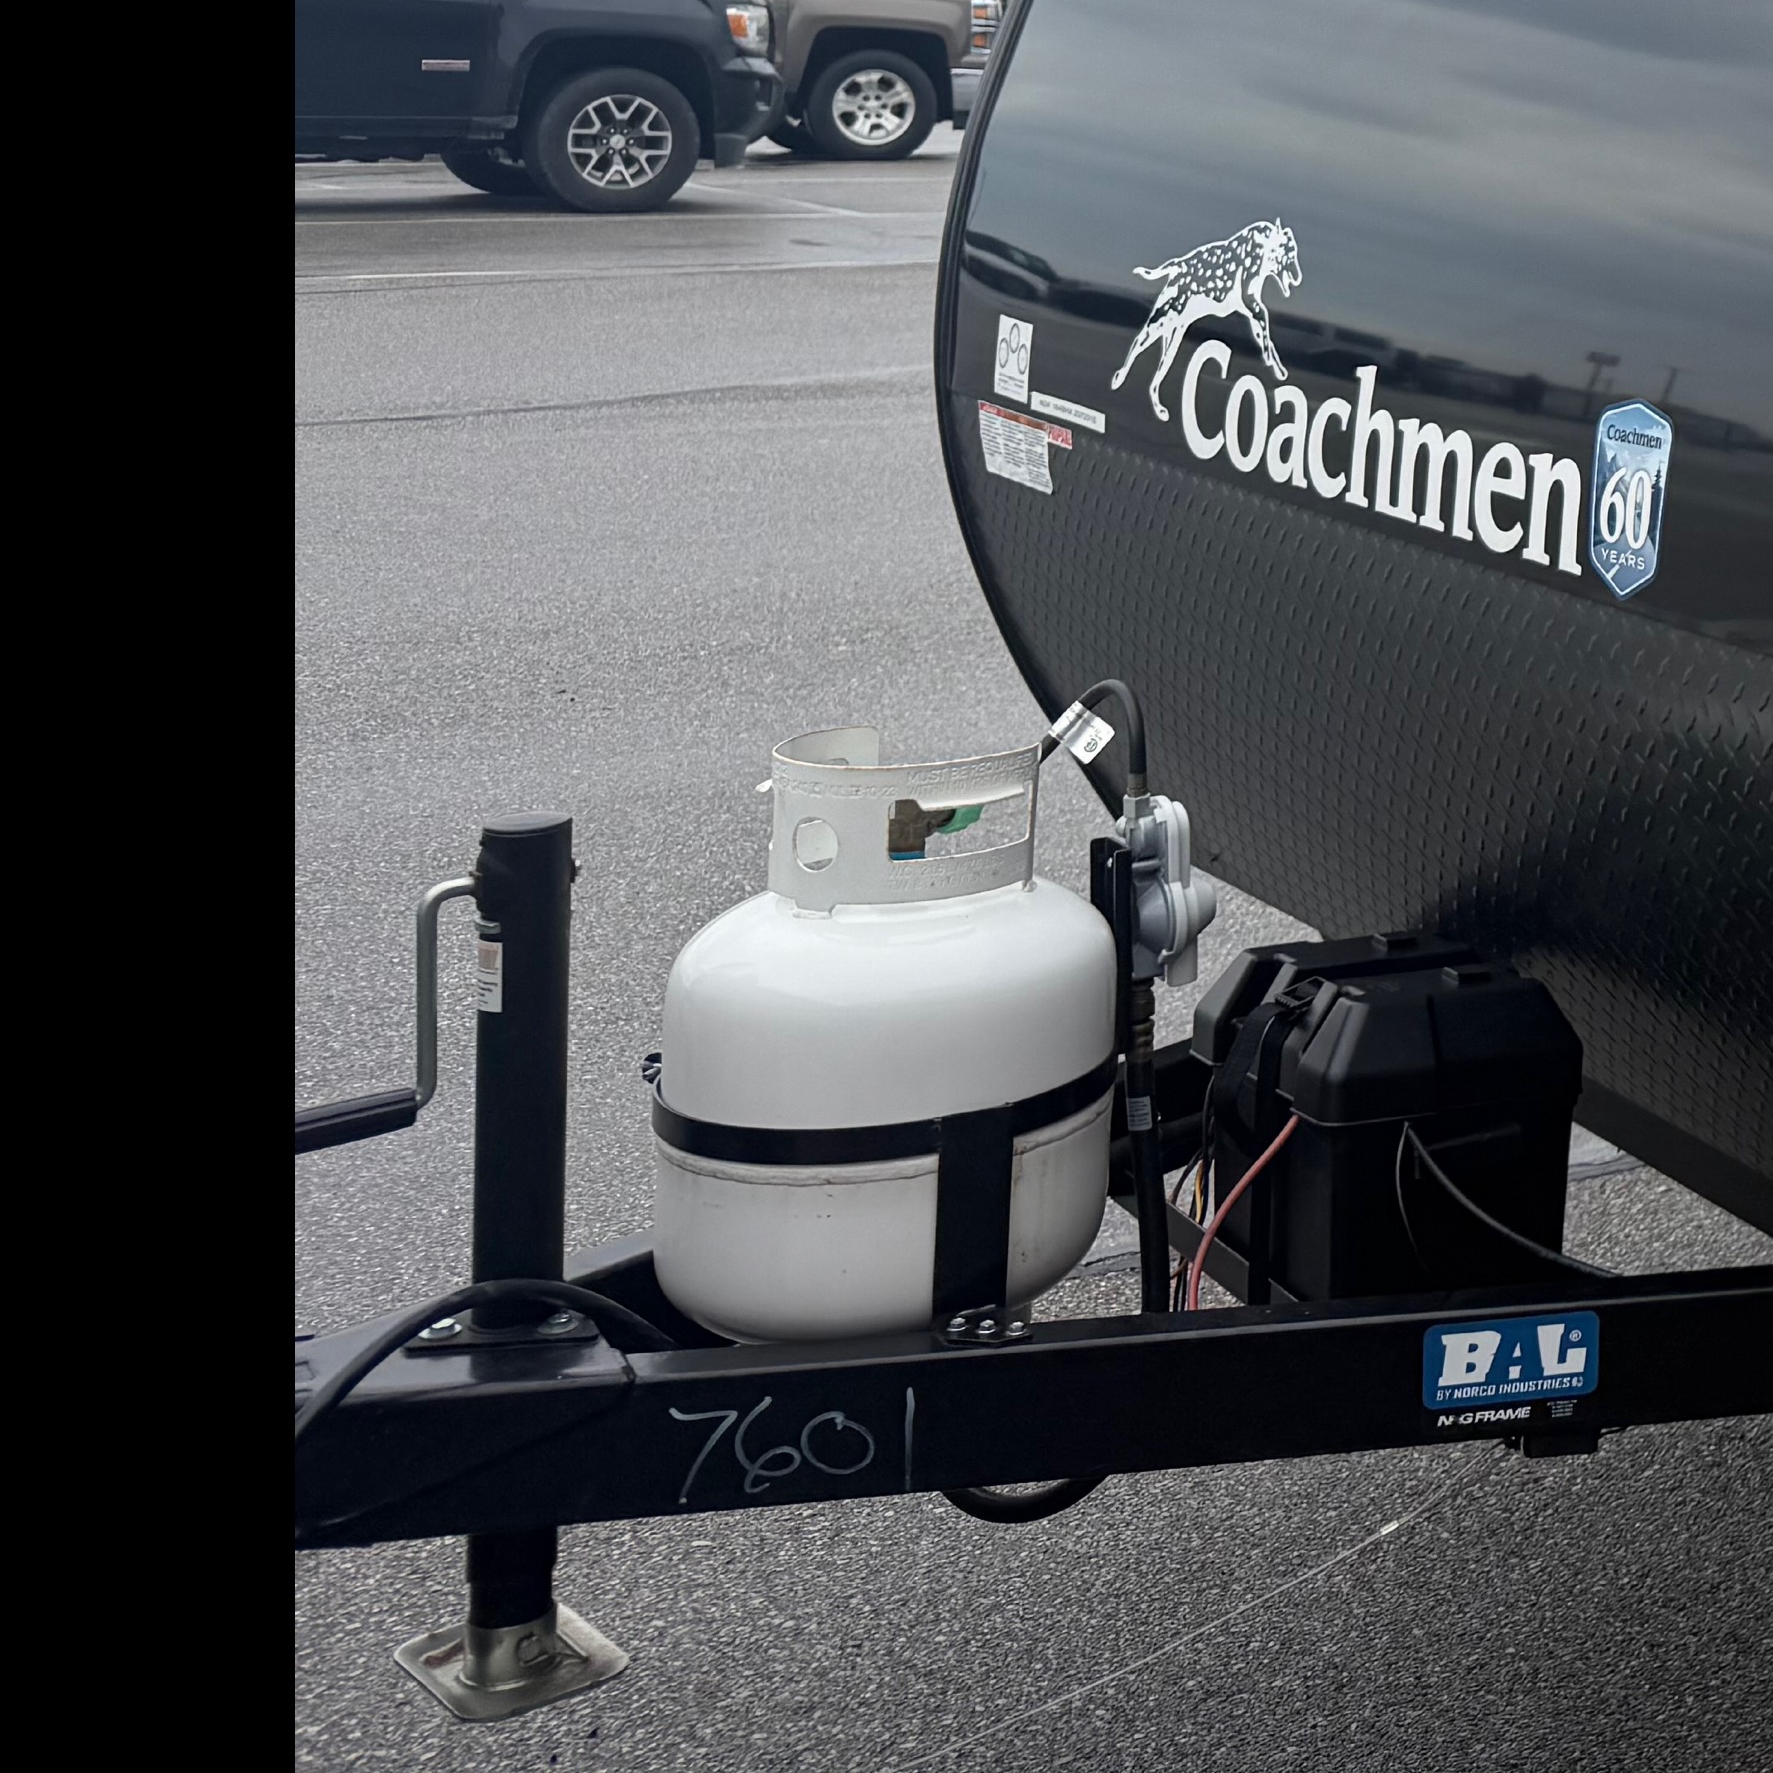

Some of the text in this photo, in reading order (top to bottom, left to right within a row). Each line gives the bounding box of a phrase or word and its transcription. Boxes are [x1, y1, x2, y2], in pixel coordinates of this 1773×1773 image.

[1181, 338, 1583, 576] Coachmen
[1606, 424, 1662, 450] Coachmen
[1600, 466, 1652, 550] 60
[1601, 547, 1646, 571] YEARS
[1438, 1324, 1587, 1387] BAL
[1436, 1377, 1571, 1401] BY NORCO INDUSTRIES
[1474, 1406, 1532, 1424] FRAME
[669, 1387, 916, 1504] 7601
